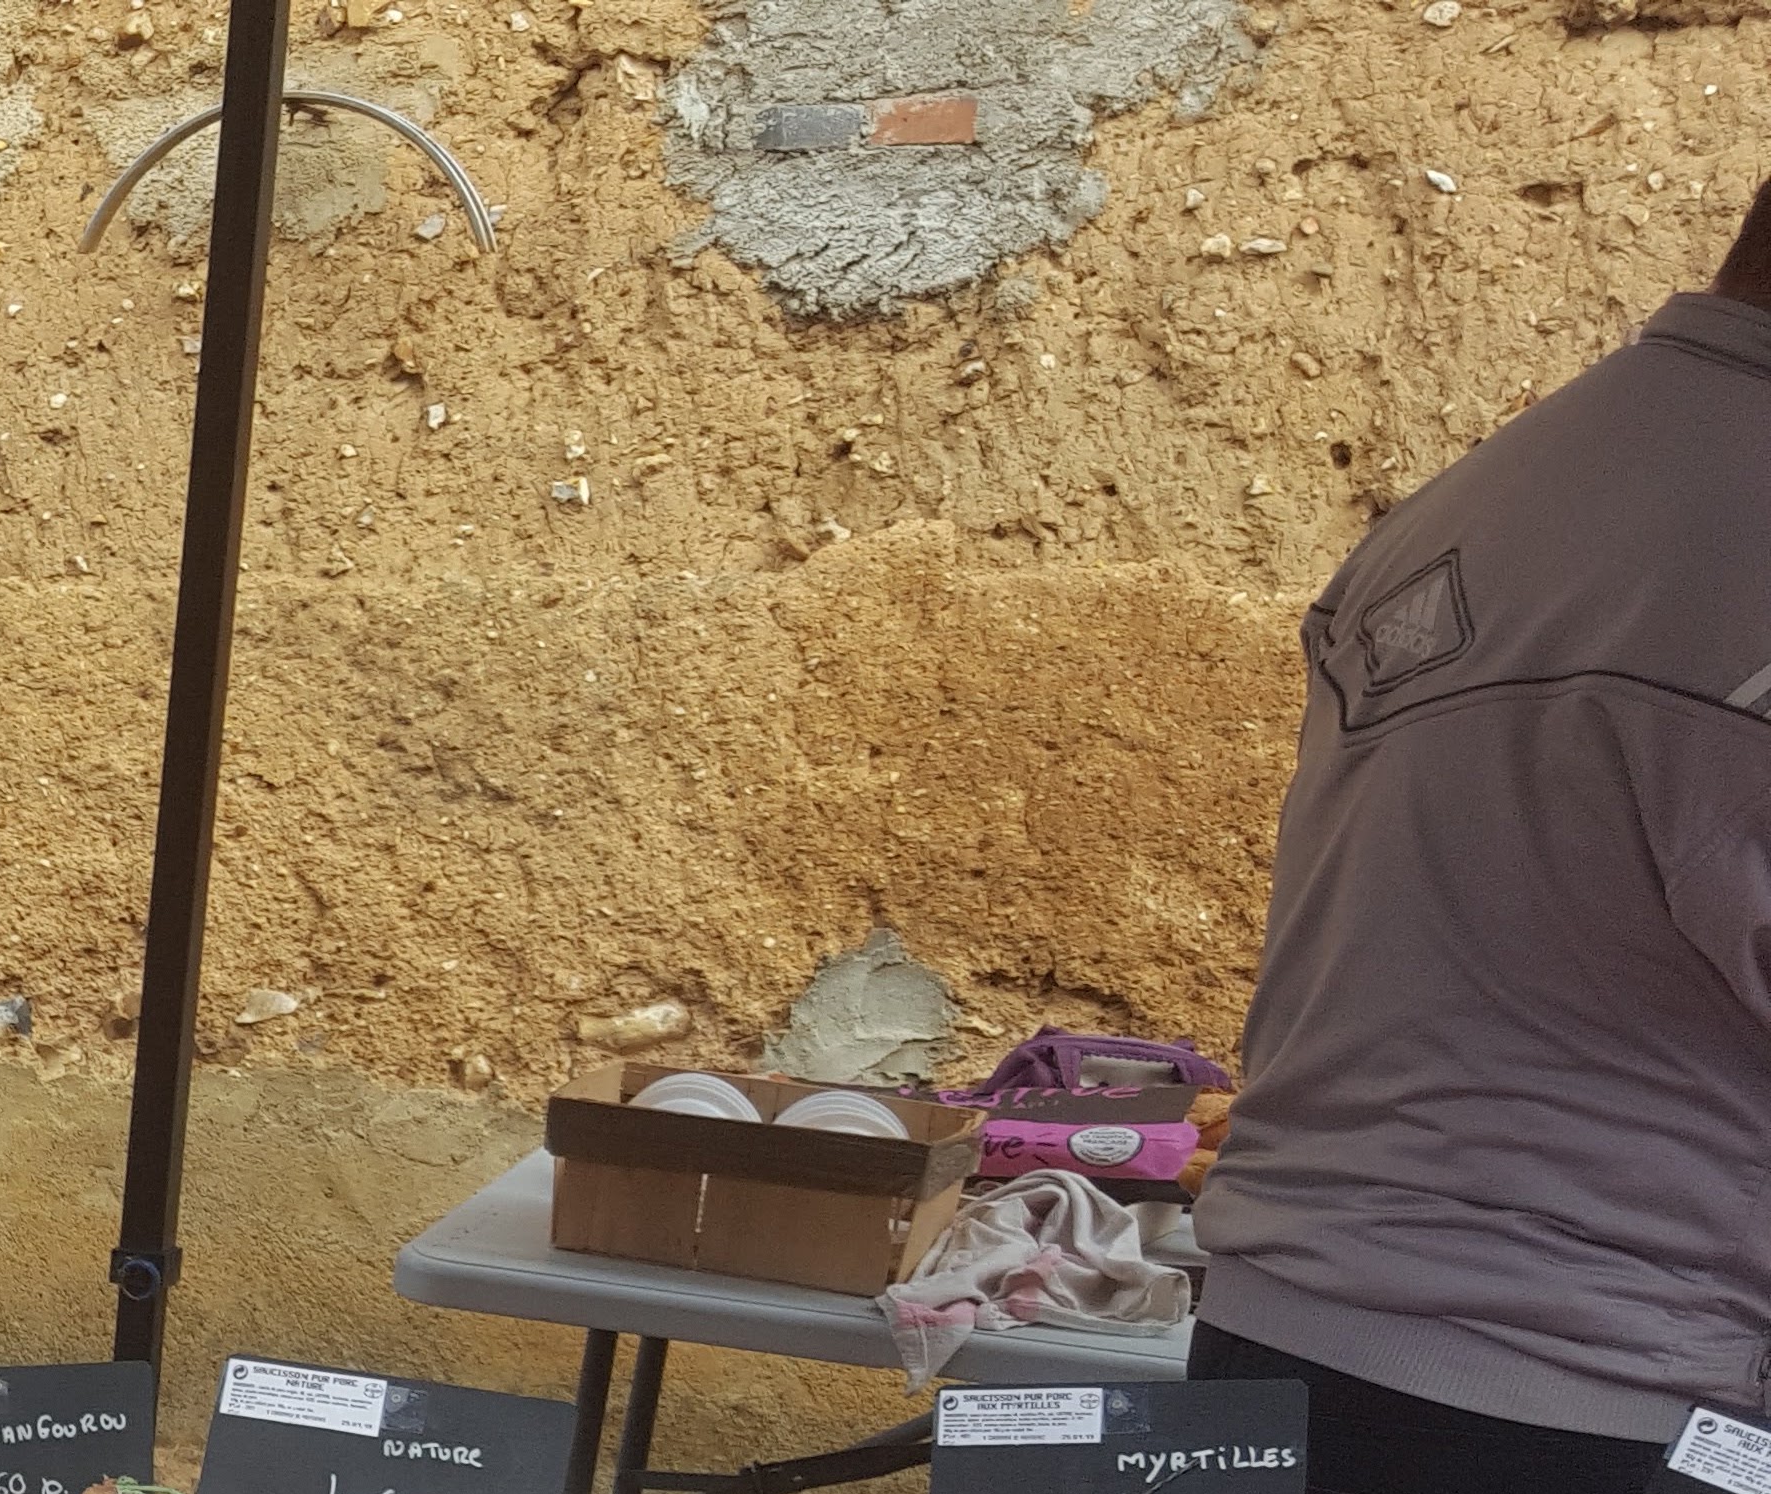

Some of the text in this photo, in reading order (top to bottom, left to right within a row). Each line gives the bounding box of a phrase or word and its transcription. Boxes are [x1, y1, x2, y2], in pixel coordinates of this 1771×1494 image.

[253, 1365, 359, 1388] SAUCISSON PUR PORC
[285, 1378, 325, 1392] NATURE
[962, 1391, 1073, 1403] SAUCISSON PUR PORC
[976, 1400, 1062, 1411] AUX MYRTILLES
[1737, 1439, 1766, 1456] AUX
